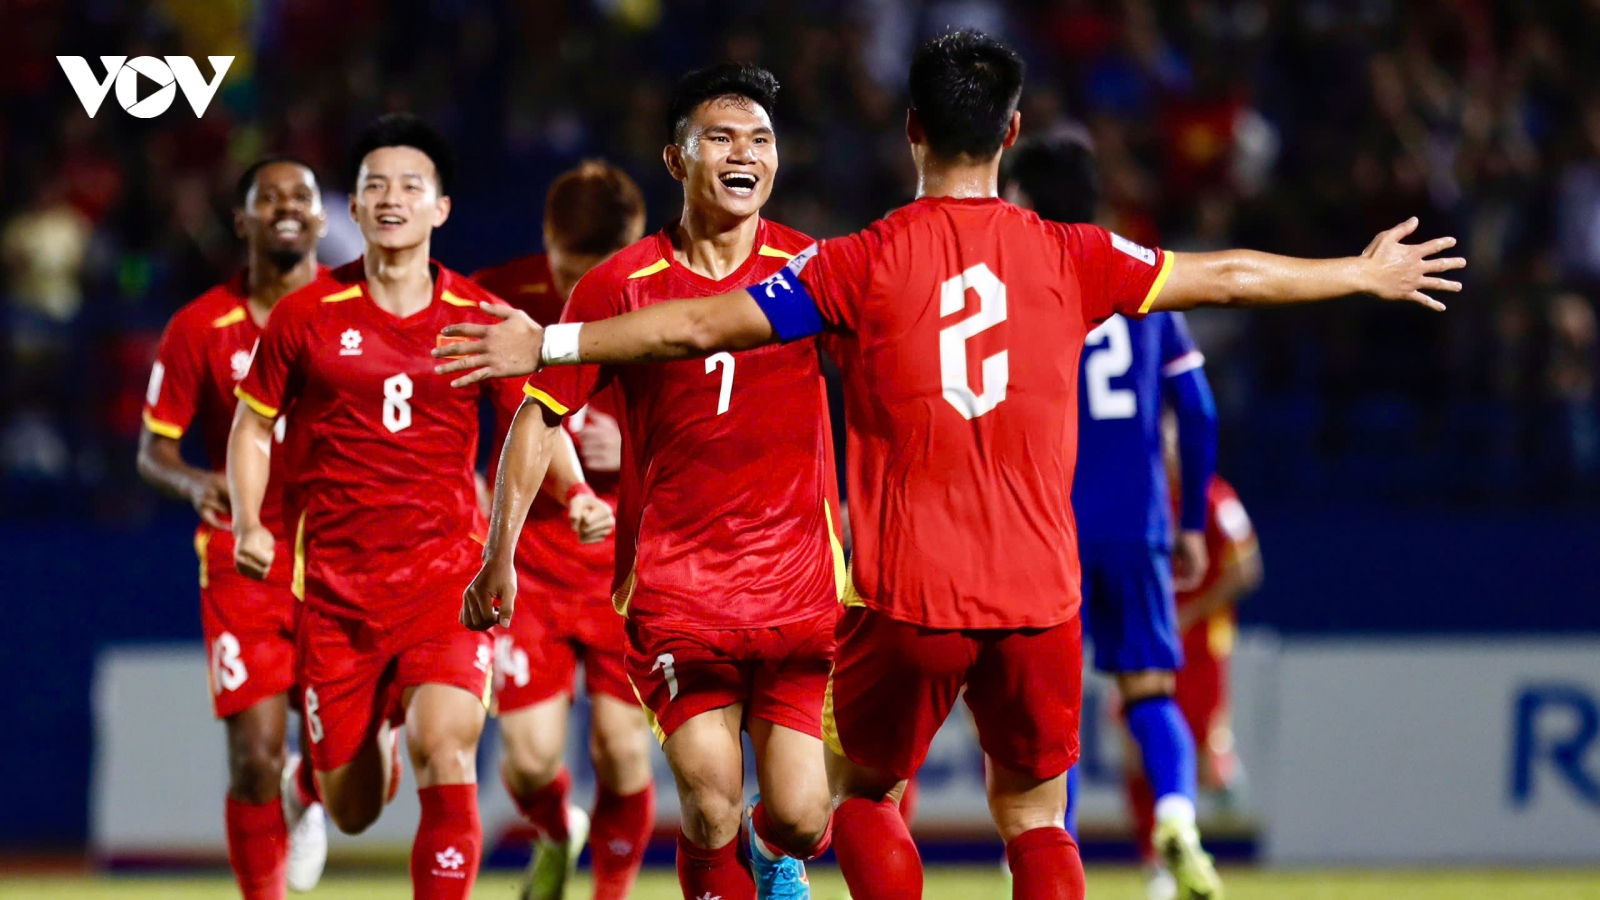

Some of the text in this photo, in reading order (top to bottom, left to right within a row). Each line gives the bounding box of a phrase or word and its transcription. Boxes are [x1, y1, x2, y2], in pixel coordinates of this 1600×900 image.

[939, 262, 1009, 420] 2
[1085, 312, 1137, 420] 2
[383, 372, 414, 434] 8
[704, 351, 736, 416] 7
[305, 687, 324, 744] 8
